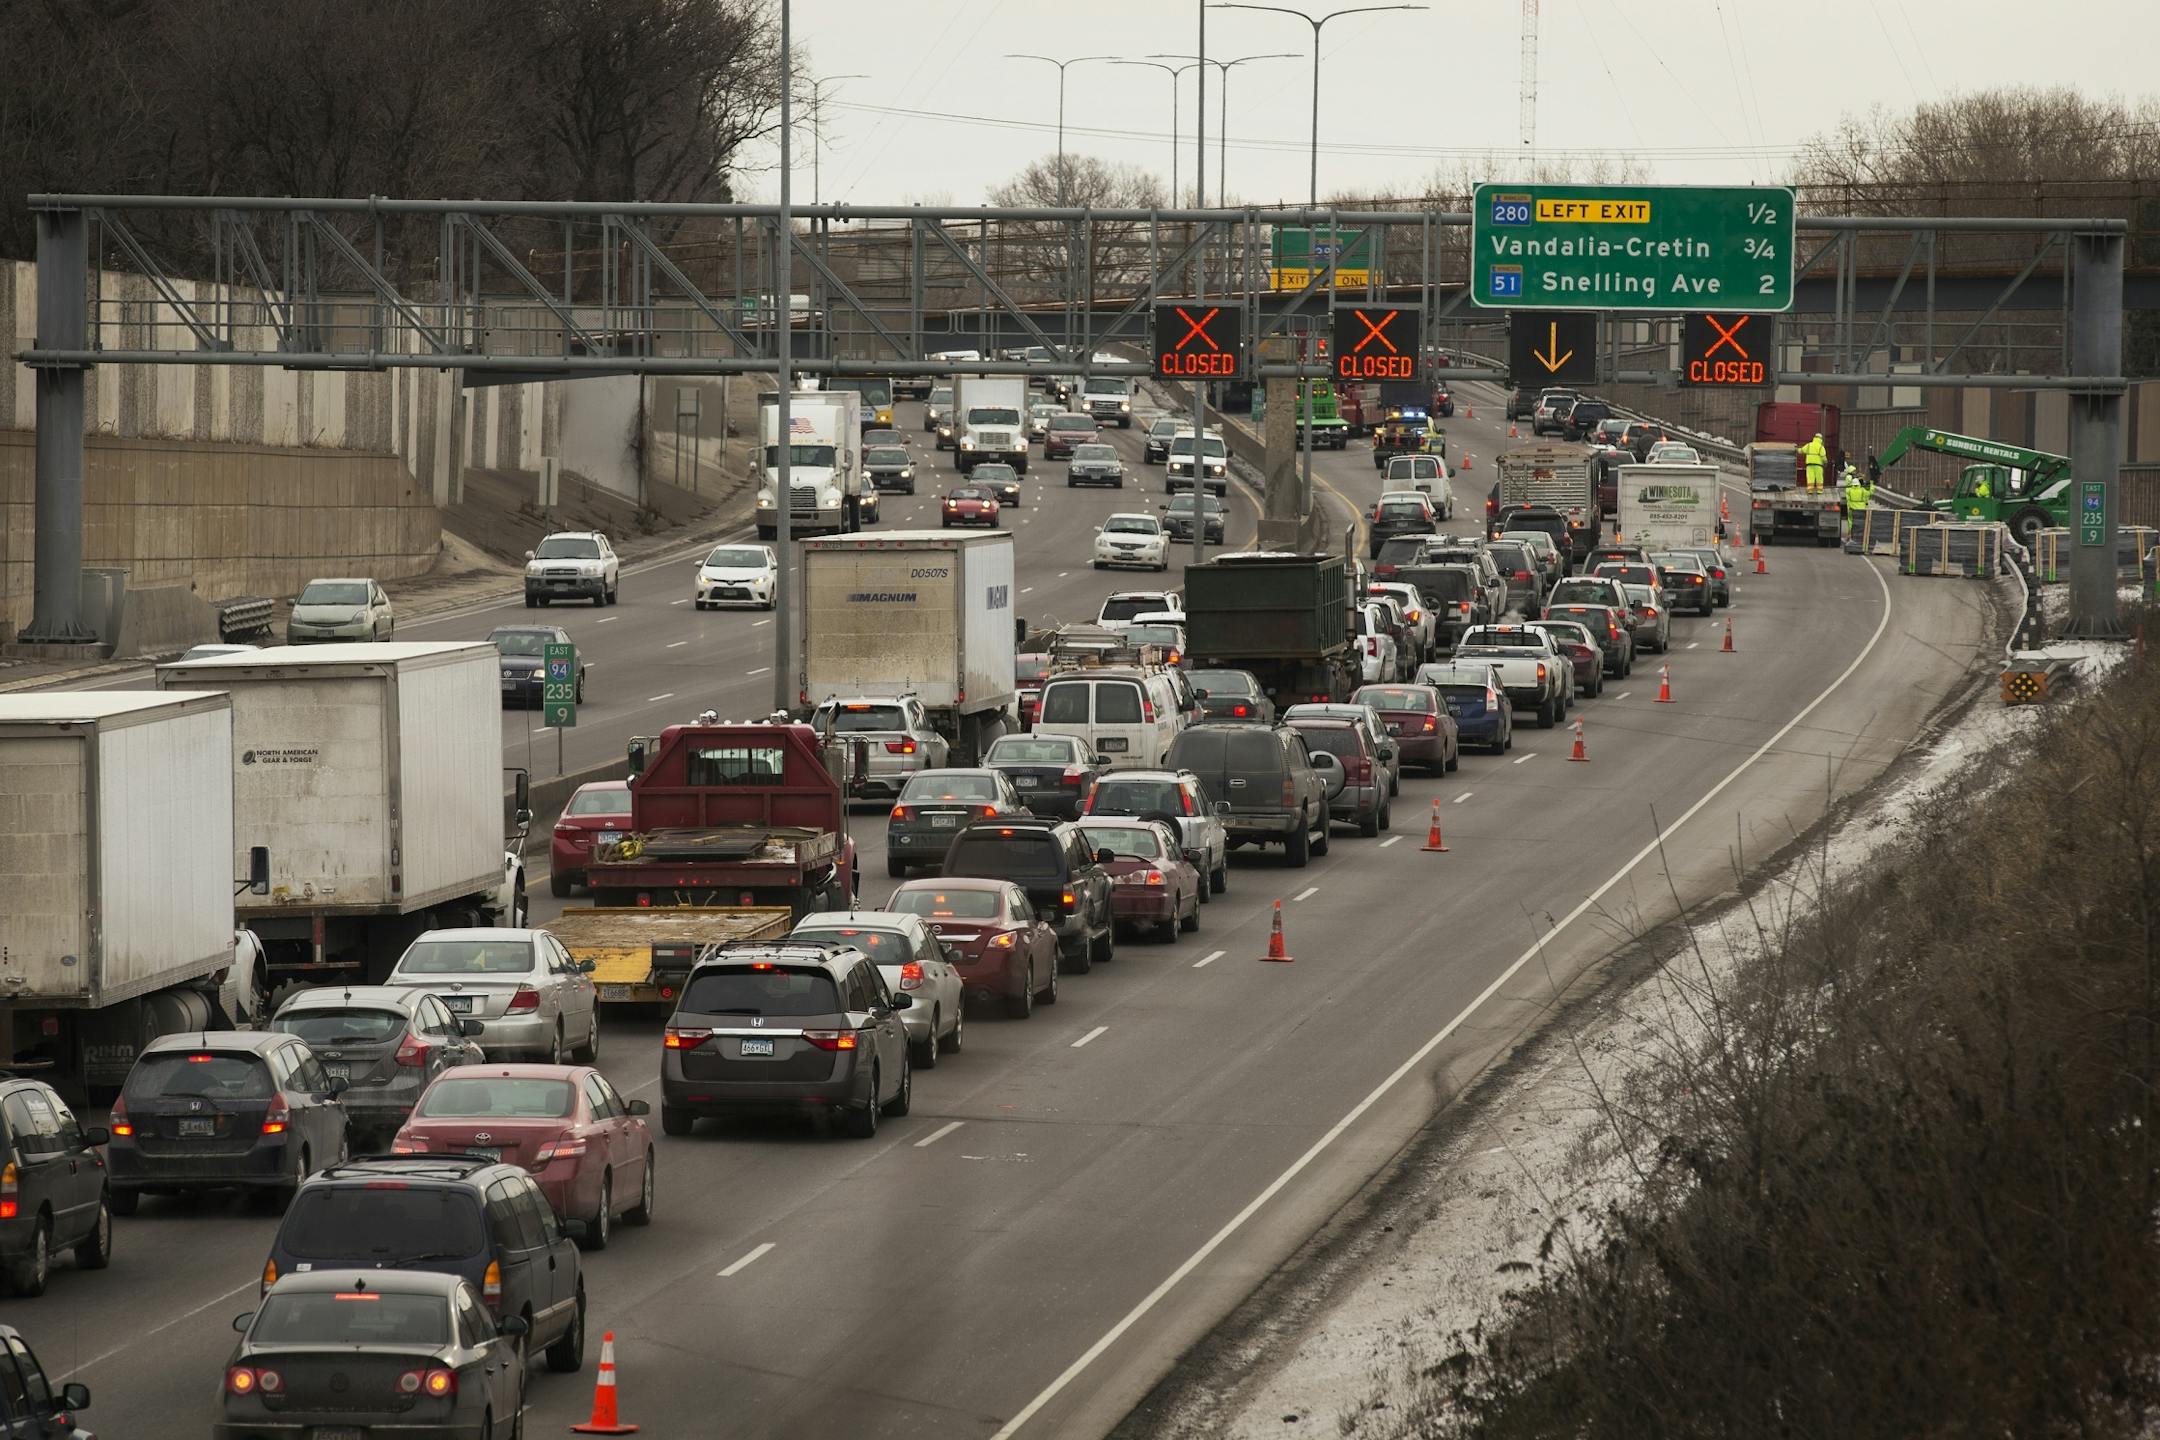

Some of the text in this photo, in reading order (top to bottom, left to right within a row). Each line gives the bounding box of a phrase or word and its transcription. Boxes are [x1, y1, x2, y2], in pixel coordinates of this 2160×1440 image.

[1495, 202, 1777, 224] 280 LEFT EXIT 1/2
[1491, 235, 1776, 260] Vandalia-Cretin 3/4
[1494, 271, 1775, 298] 51 Snelling Ave 2
[1161, 353, 1235, 375] CLOSED
[1340, 355, 1413, 377] CLOSED
[1690, 360, 1764, 383] CLOSED
[1946, 438, 2020, 460] SUNBELT RENTALS
[1648, 485, 1692, 499] WINNESOTA
[2085, 484, 2102, 492] EAST
[2087, 498, 2099, 506] 94
[2083, 512, 2103, 525] 235
[858, 593, 917, 602] MAGNUM
[549, 646, 568, 655] EAST
[551, 663, 567, 676] 94
[546, 683, 574, 700] 235
[256, 748, 319, 757] NORTH AMERICAN
[289, 756, 313, 764] FORGE
